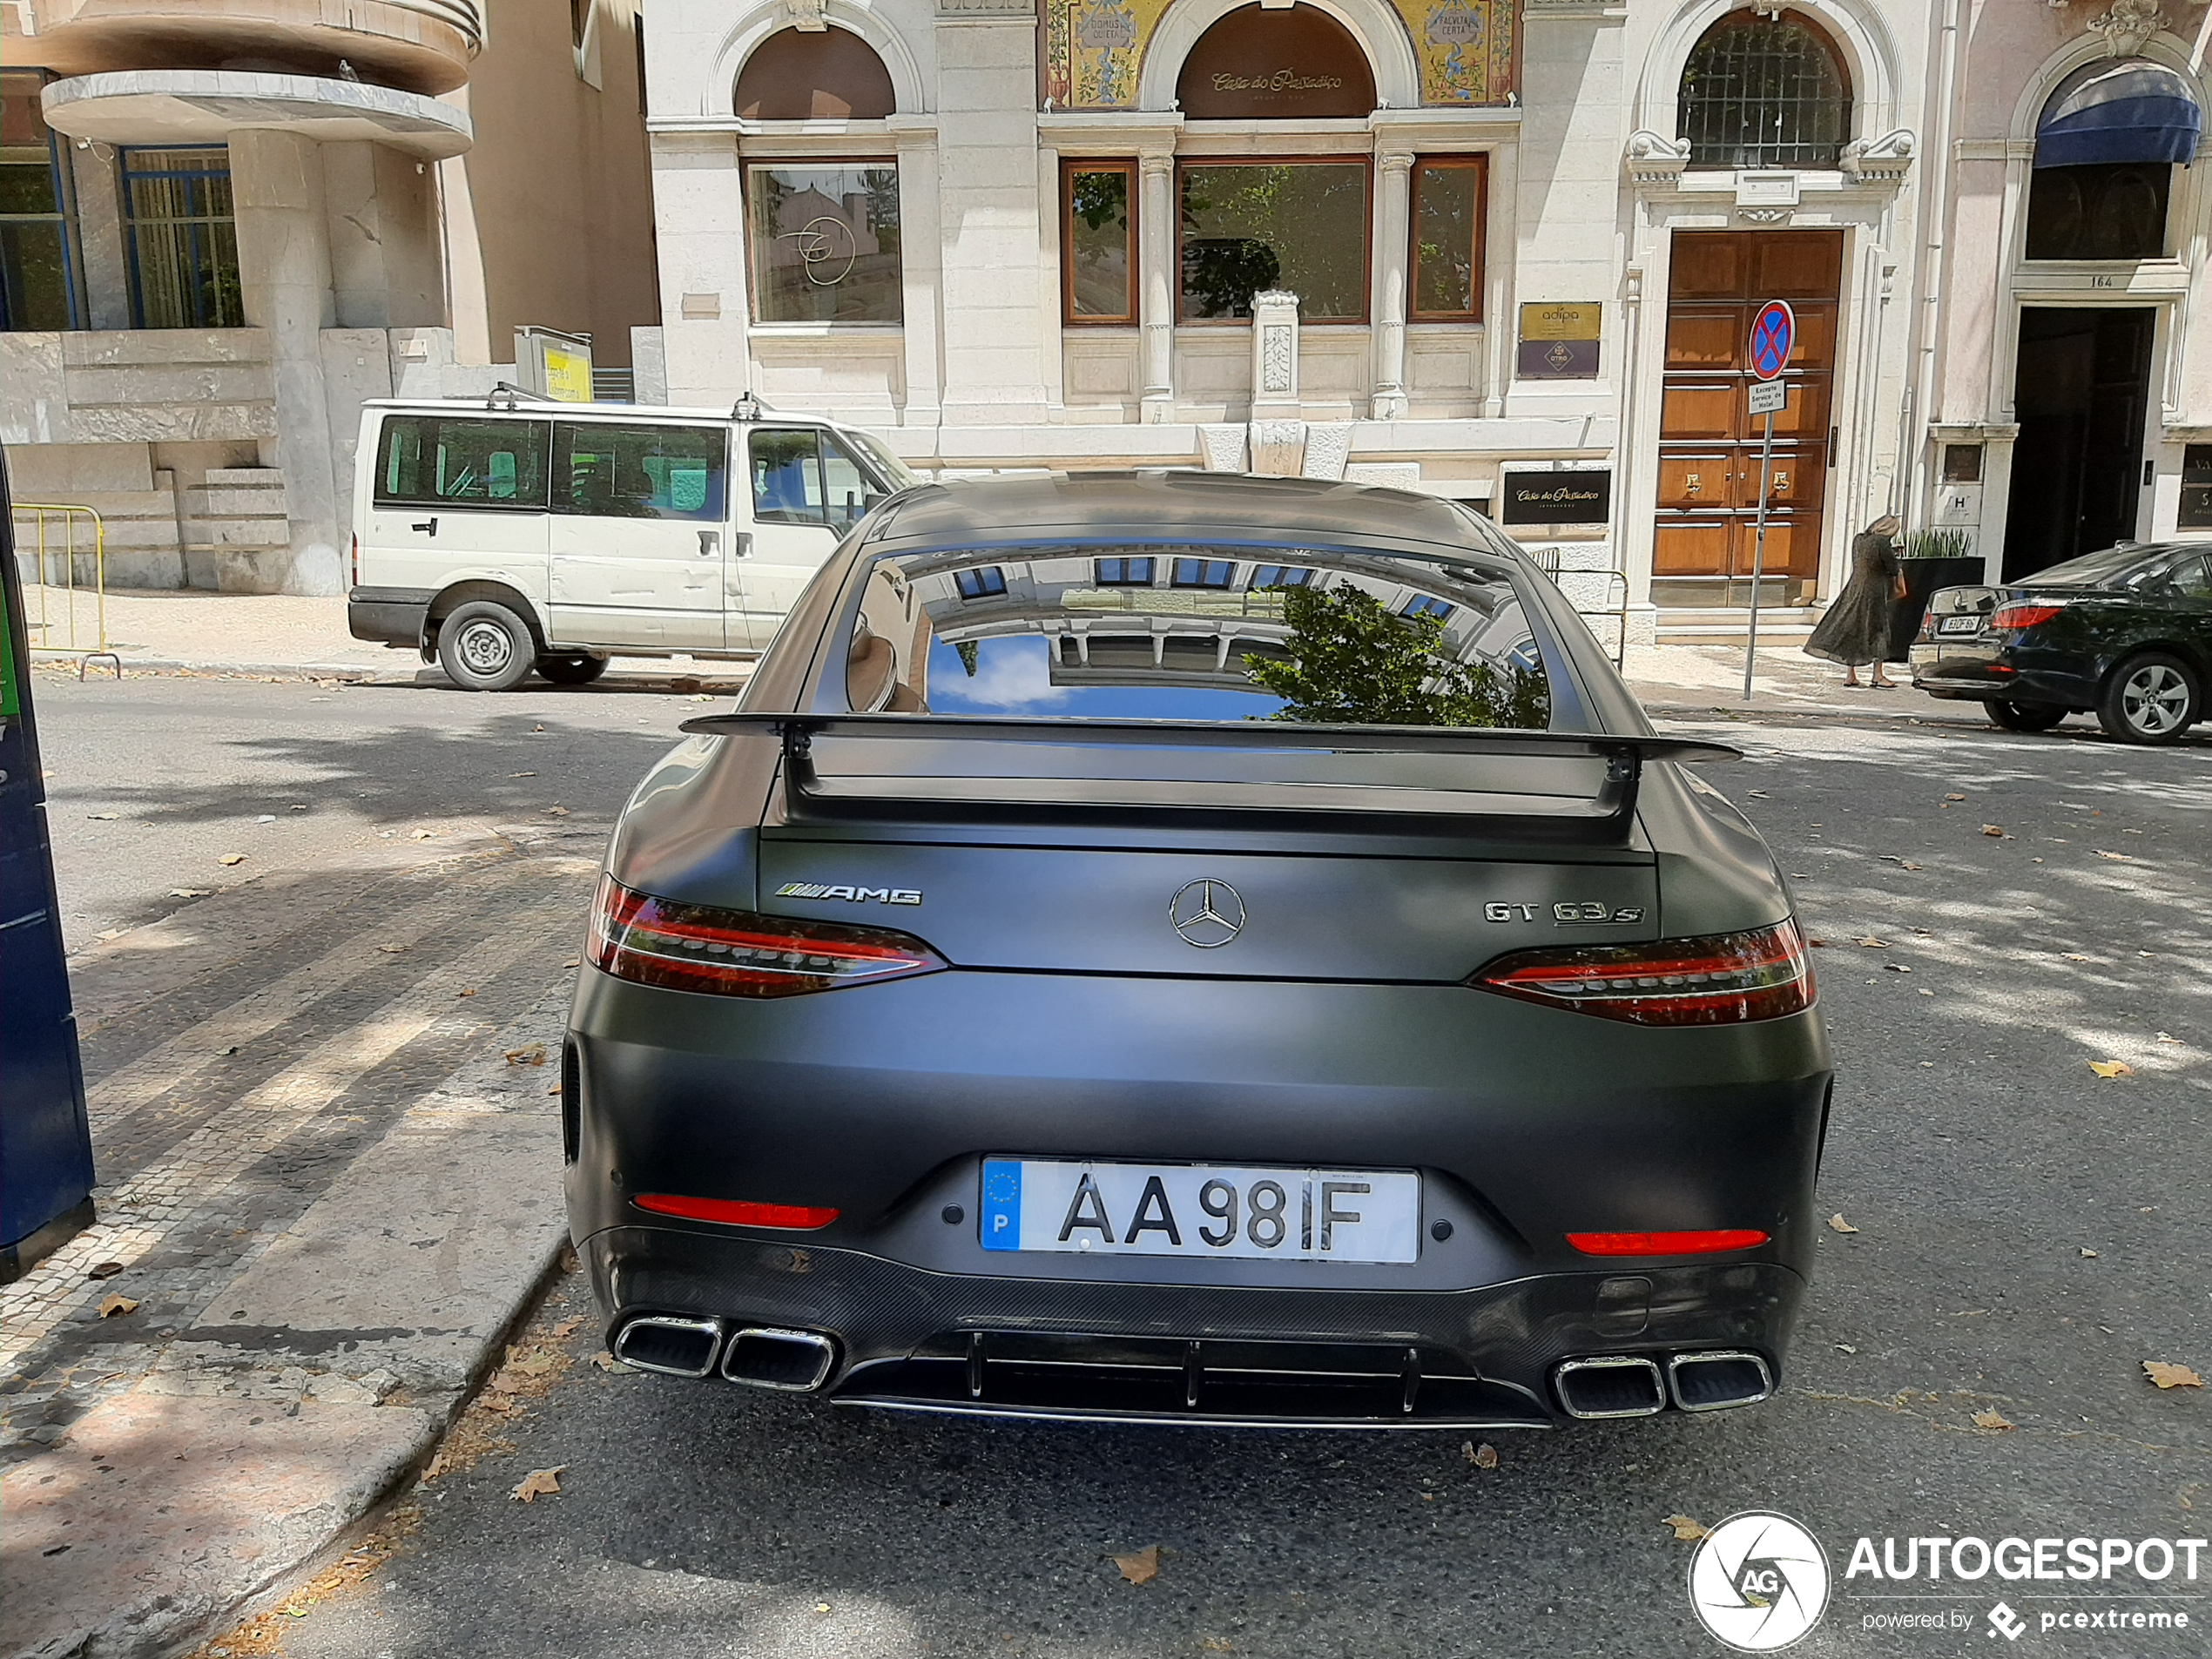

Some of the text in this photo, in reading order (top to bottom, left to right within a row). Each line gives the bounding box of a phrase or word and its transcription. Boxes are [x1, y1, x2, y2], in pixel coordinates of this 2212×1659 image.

[1091, 19, 1119, 29] DOMUS
[1442, 25, 1466, 35] CERTA
[1211, 73, 1250, 91] Casa
[1251, 75, 1269, 89] do
[2090, 275, 2112, 288] 164
[1758, 401, 1774, 409] Hotel
[1516, 489, 1540, 502] Casa
[1541, 491, 1553, 500] do
[1955, 497, 1965, 509] H
[1484, 902, 1539, 921] GT
[994, 1214, 1008, 1233] P
